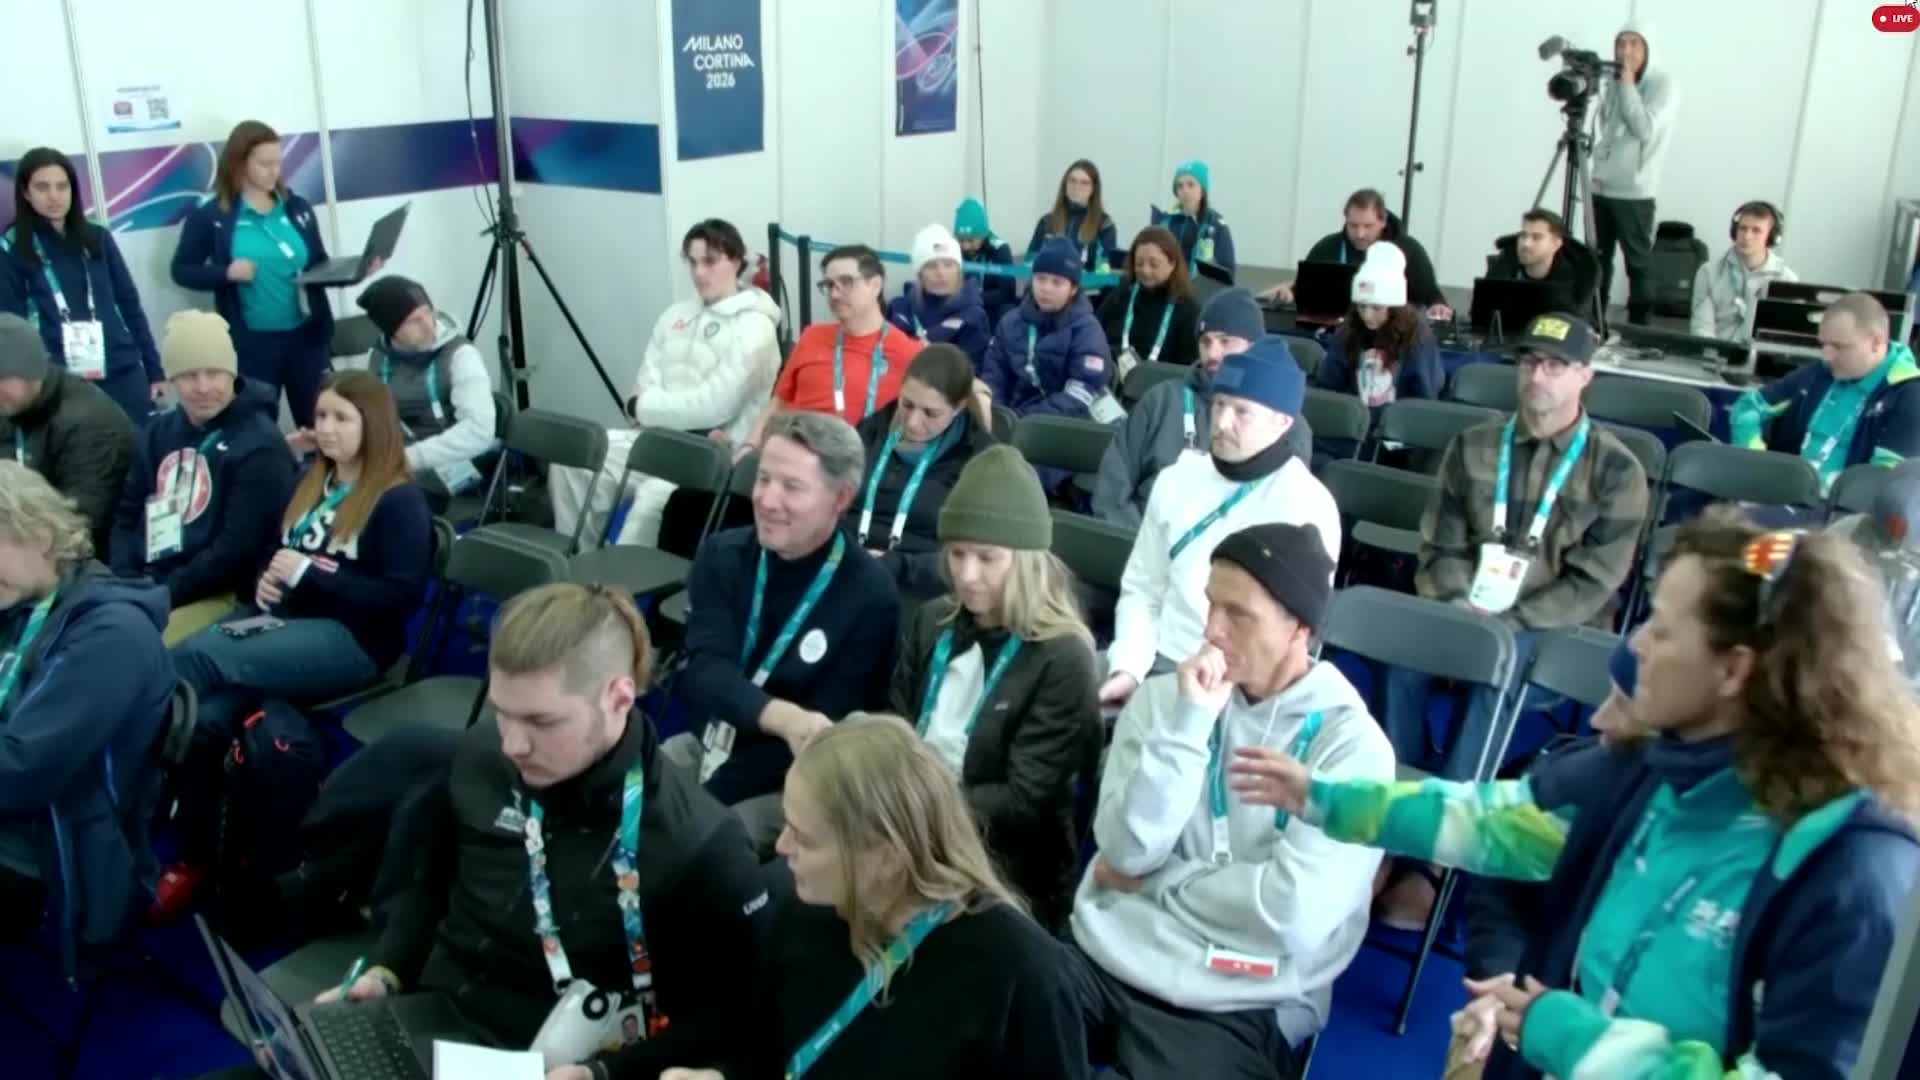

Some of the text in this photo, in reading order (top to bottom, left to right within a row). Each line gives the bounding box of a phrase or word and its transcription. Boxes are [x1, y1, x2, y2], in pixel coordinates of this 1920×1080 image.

[683, 33, 744, 52] MILANO
[694, 52, 755, 71] CORTINA
[706, 71, 736, 88] 2026
